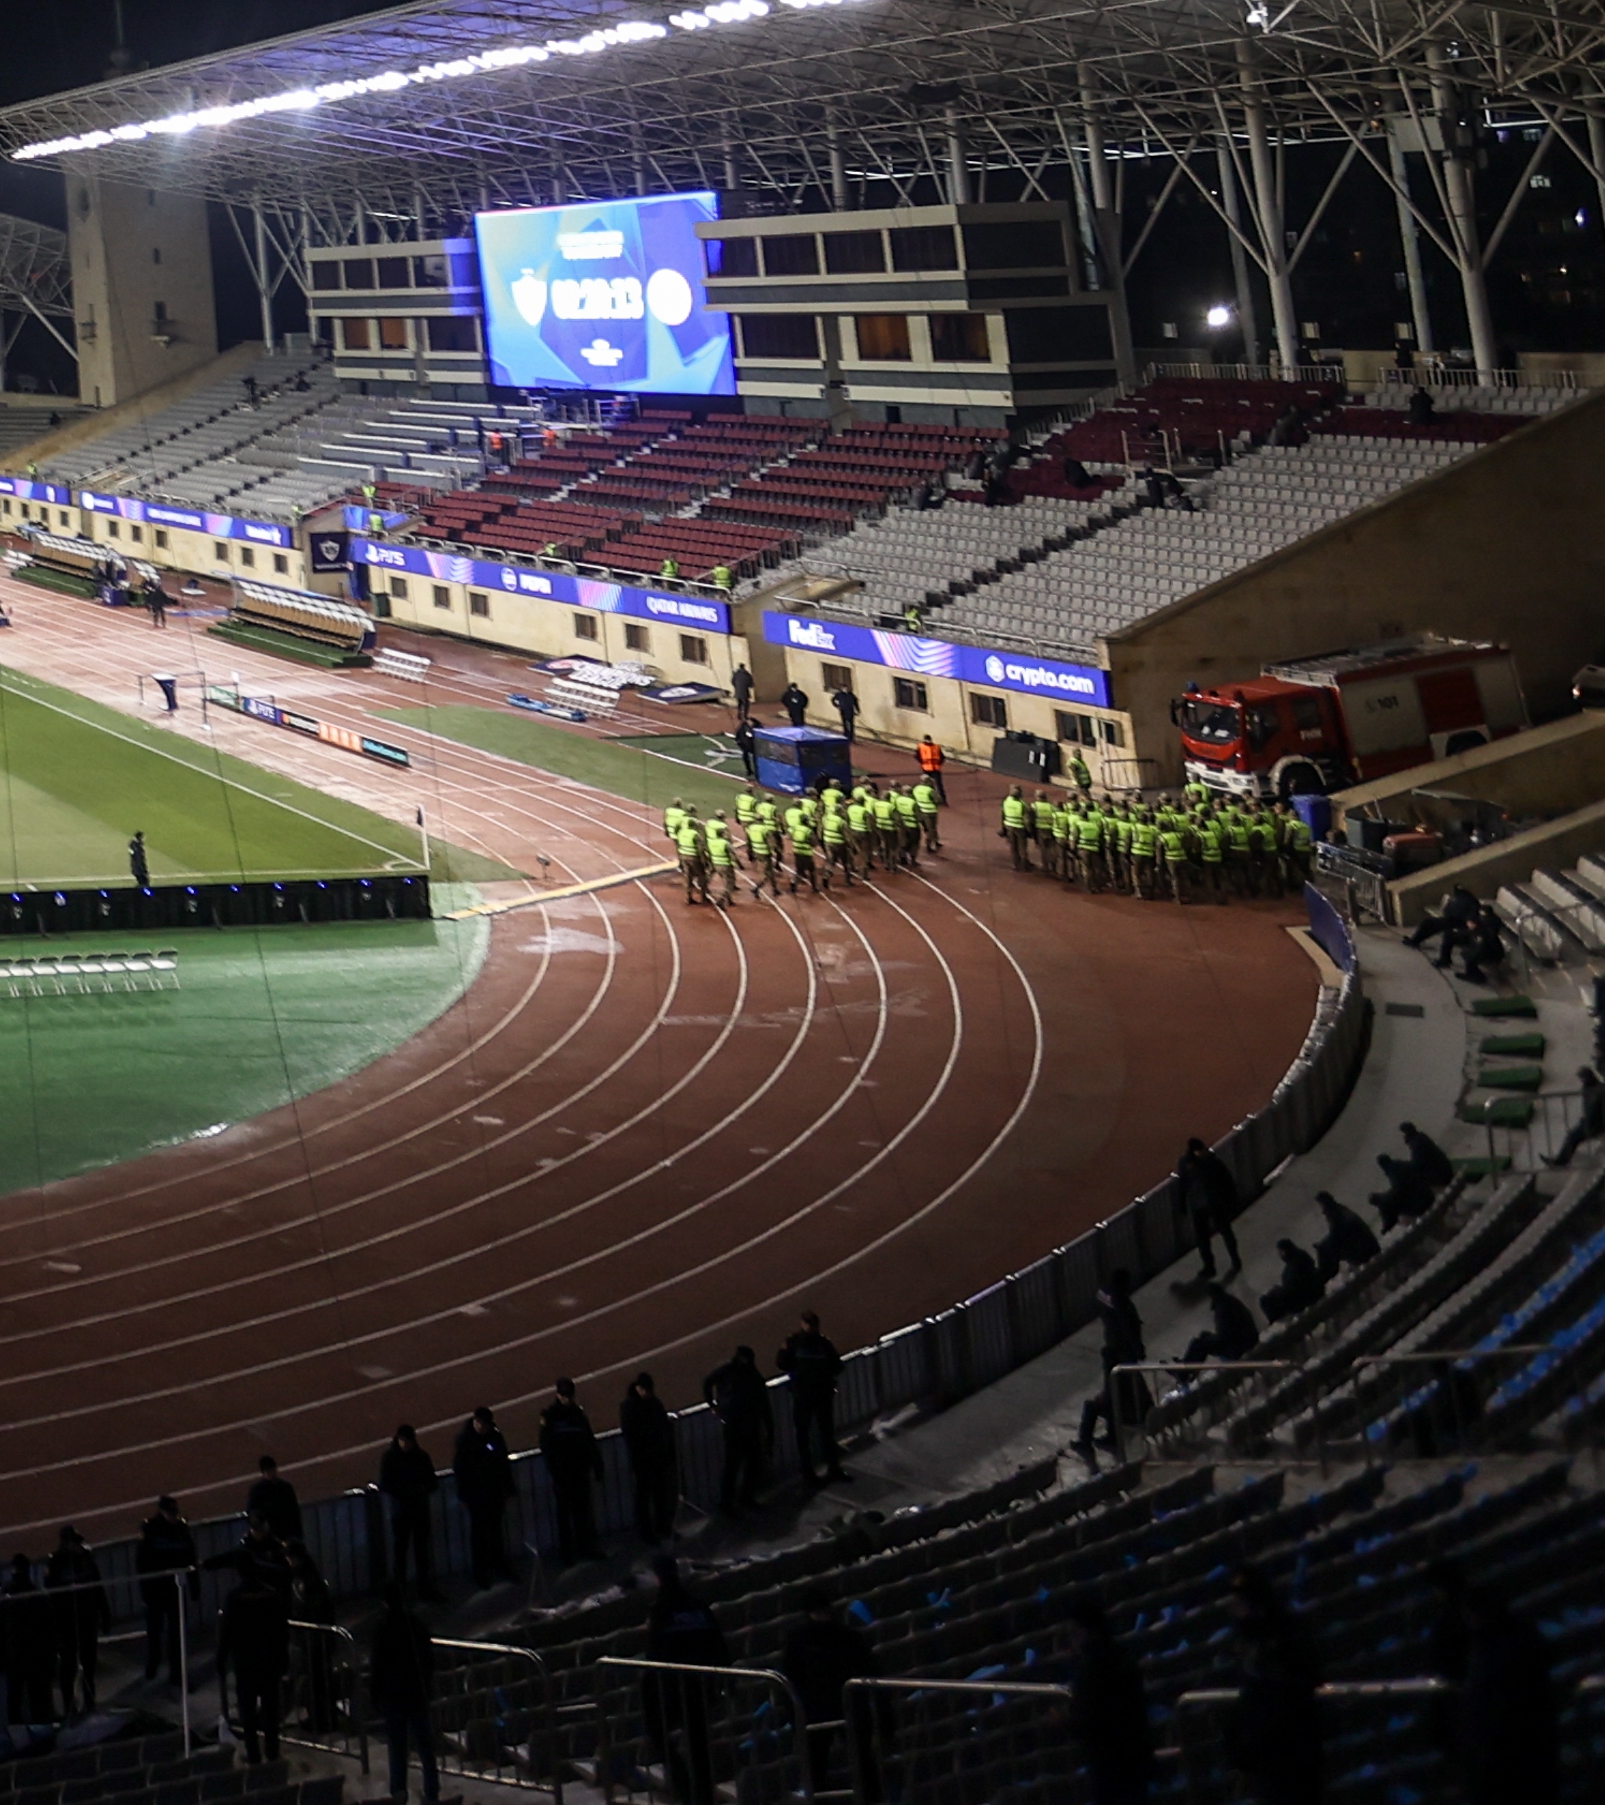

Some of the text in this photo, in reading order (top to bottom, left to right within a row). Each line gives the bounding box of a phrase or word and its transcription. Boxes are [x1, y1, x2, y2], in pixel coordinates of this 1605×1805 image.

[379, 549, 405, 565] PS5
[646, 596, 718, 622] QATAR AIRWAYS
[789, 620, 836, 650] FedEx
[1006, 662, 1095, 694] crypto.com
